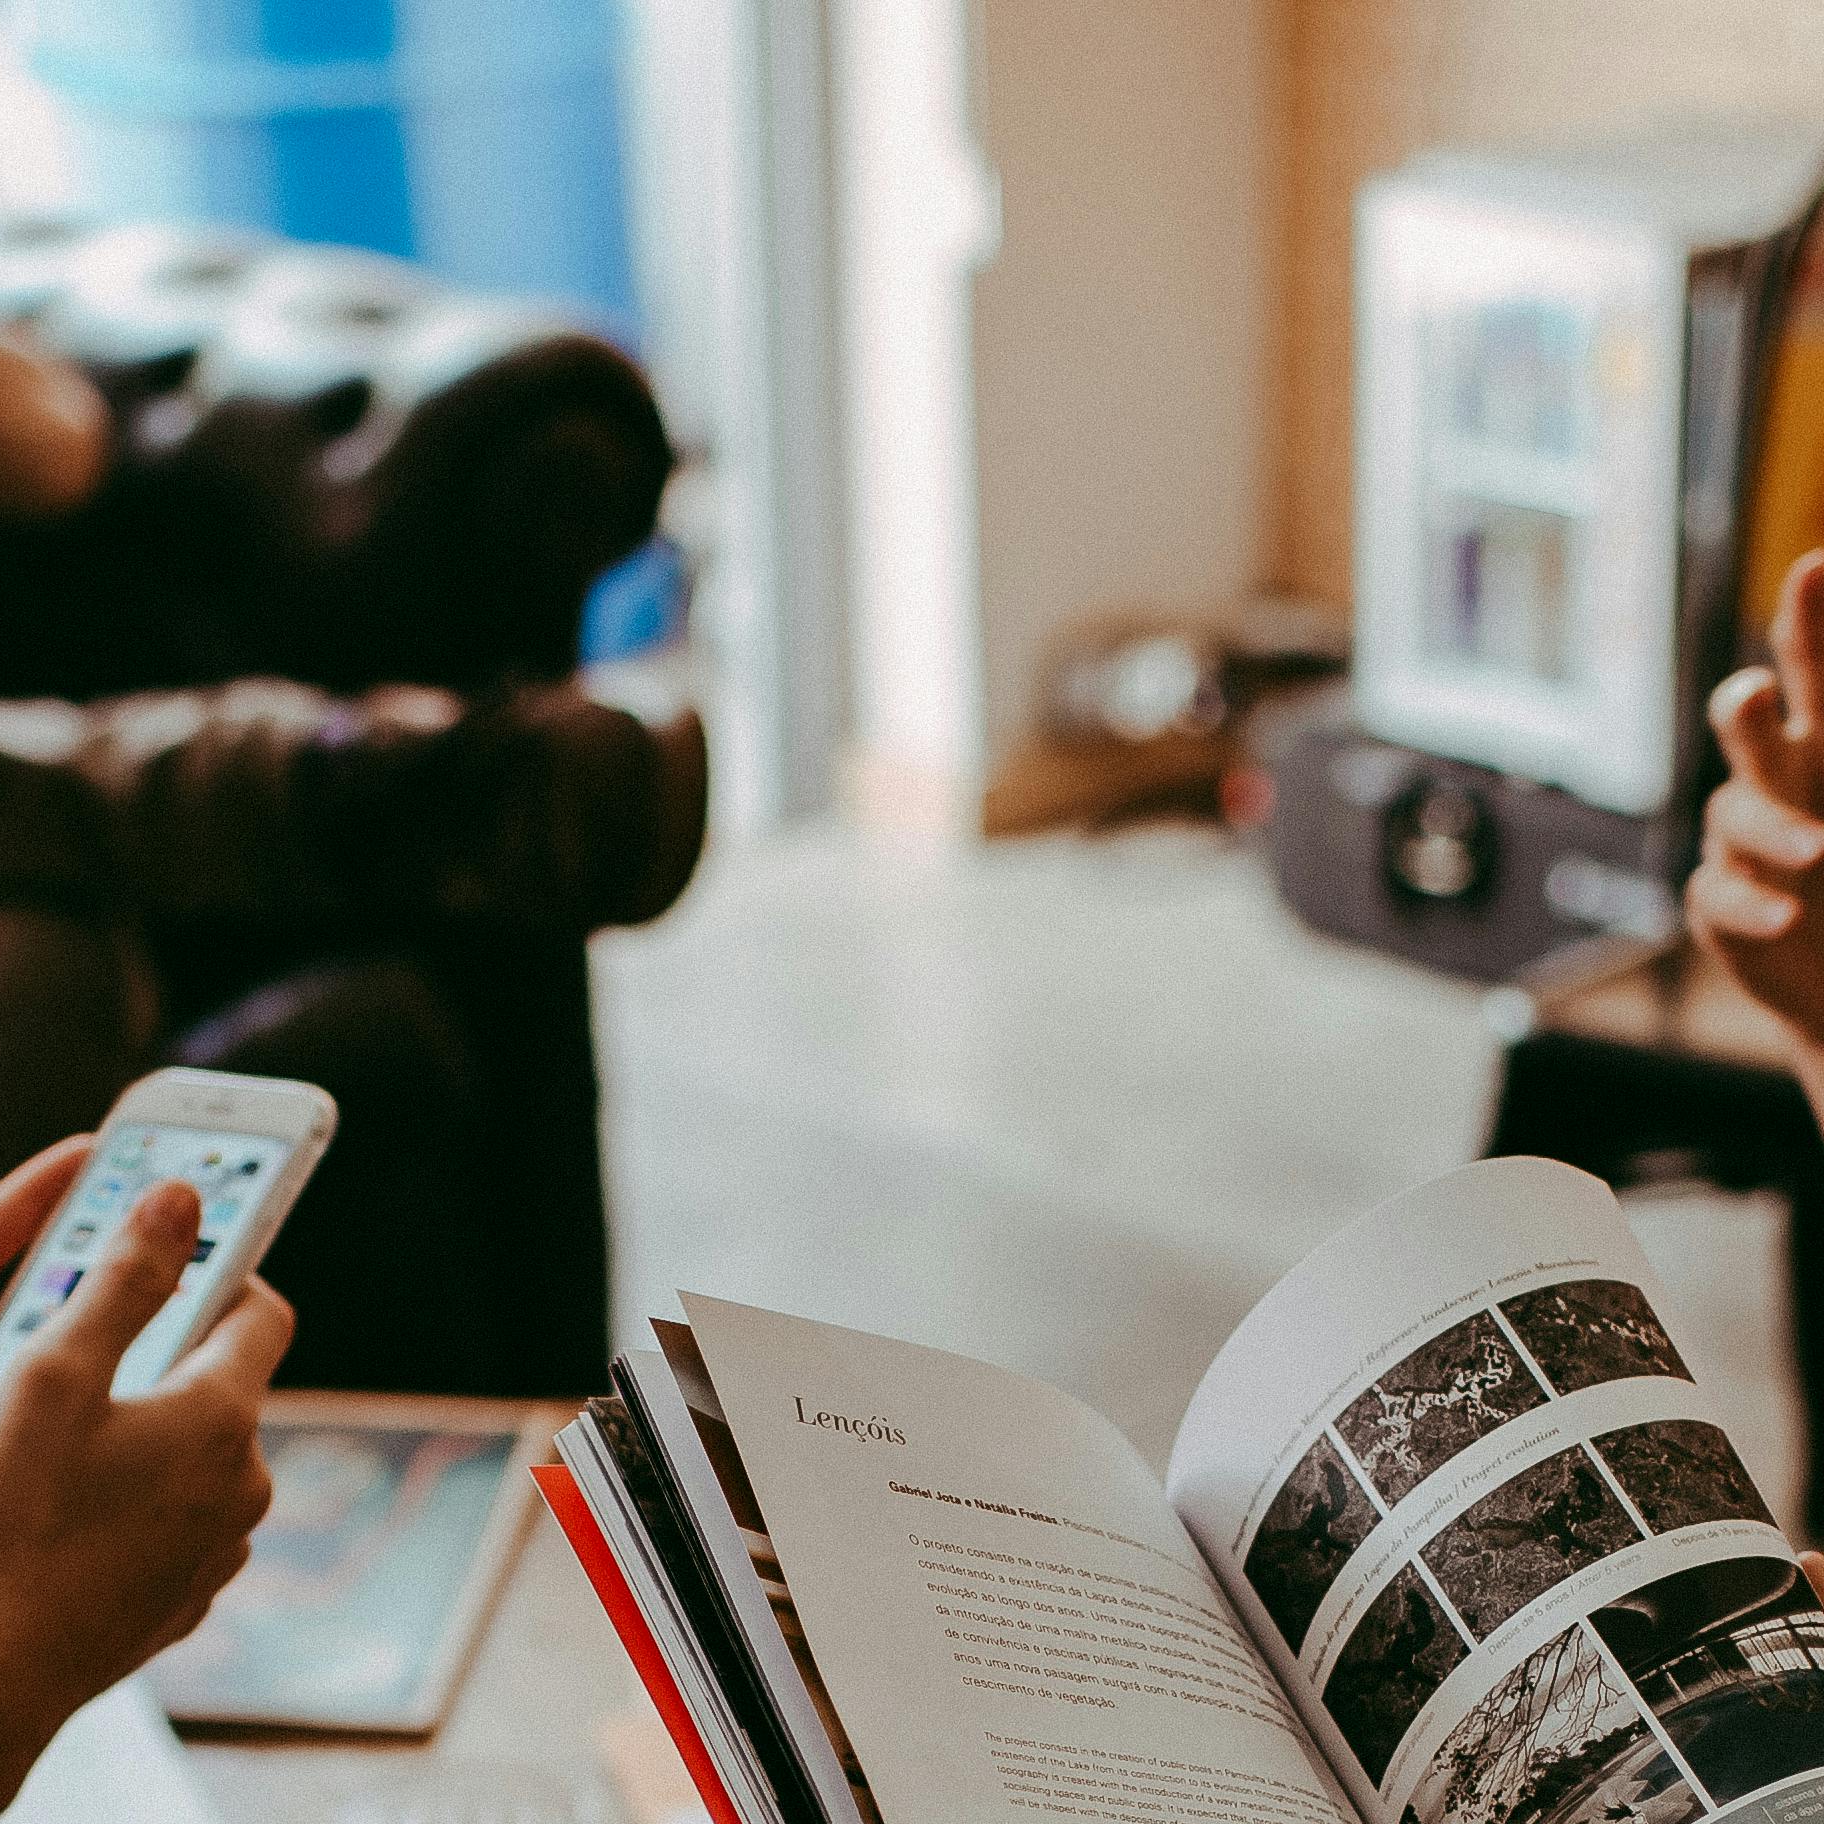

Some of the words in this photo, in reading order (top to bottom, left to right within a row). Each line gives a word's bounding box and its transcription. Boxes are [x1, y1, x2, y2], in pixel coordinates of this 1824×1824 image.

[792, 1395, 907, 1446] Lençóis
[888, 1480, 932, 1498] Gabriel
[936, 1491, 961, 1504] Jota
[1390, 1538, 1404, 1553] da
[1403, 1493, 1454, 1538] Pampulha
[1462, 1457, 1502, 1489] Project
[1505, 1427, 1560, 1460] evolution
[922, 1539, 963, 1554] projeto
[966, 1547, 1014, 1564] consiste
[1017, 1557, 1032, 1567] na
[1034, 1560, 1074, 1575] criação
[1076, 1568, 1091, 1578] de
[917, 1559, 995, 1581] considerando
[1008, 1576, 1065, 1594] existência
[1068, 1586, 1082, 1597] da
[1083, 1588, 1117, 1604] Lagoa
[926, 1582, 977, 1599] evolução
[981, 1592, 995, 1602] ao
[996, 1593, 1030, 1610] longo
[1032, 1601, 1054, 1613] dos
[1057, 1606, 1087, 1618] anos.
[1090, 1610, 1117, 1624] Uma
[1119, 1618, 1146, 1630] nova
[1487, 1626, 1520, 1655] Depois
[1522, 1615, 1535, 1628] de
[1544, 1591, 1570, 1611] anos
[1578, 1570, 1602, 1590] After
[1613, 1554, 1642, 1571] years
[935, 1604, 950, 1615] da
[953, 1609, 1014, 1627] introdução
[1016, 1620, 1031, 1630] de
[1034, 1624, 1060, 1635] uma
[1062, 1628, 1097, 1641] malha
[1100, 1634, 1147, 1651] metálica
[944, 1627, 959, 1639] de
[962, 1632, 1030, 1651] convivência
[1043, 1646, 1090, 1661] piscinas
[953, 1652, 981, 1664] anos
[984, 1659, 1010, 1670] uma
[1013, 1663, 1040, 1675] nova
[1043, 1668, 1099, 1684] paisagem
[1101, 1677, 1141, 1691] surgirá
[1143, 1684, 1168, 1695] com
[962, 1676, 1035, 1696] crescimento
[1037, 1687, 1052, 1698] de
[1055, 1692, 1118, 1708] vegetação.
[984, 1731, 1001, 1742] The
[1004, 1736, 1037, 1748] project
[1038, 1742, 1077, 1754] consists
[1090, 1749, 1106, 1757] the
[1108, 1752, 1145, 1763] creation
[1147, 1757, 1156, 1765] of
[1159, 1760, 1186, 1770] public
[1188, 1764, 1212, 1774] pools
[990, 1749, 1035, 1762] existence
[1037, 1755, 1047, 1764] of
[1049, 1758, 1065, 1767] the
[1067, 1760, 1090, 1770] Lake
[1092, 1763, 1114, 1773] from
[1117, 1768, 1128, 1776] its
[1130, 1770, 1186, 1784] construction
[1188, 1778, 1198, 1786] to
[1200, 1780, 1211, 1788] its
[1213, 1782, 1253, 1794] evolution
[996, 1765, 1048, 1780] topography
[1061, 1775, 1097, 1786] created
[1098, 1781, 1119, 1789] with
[1121, 1783, 1137, 1792] the
[1139, 1787, 1193, 1799] introduction
[1195, 1793, 1204, 1802] of
[1215, 1798, 1237, 1808] wavy
[1240, 1801, 1274, 1813] metallic
[1002, 1781, 1050, 1797] socializing
[1053, 1789, 1085, 1800] spaces
[1088, 1794, 1105, 1803] and
[1107, 1797, 1134, 1807] public
[1137, 1801, 1163, 1812] pools.
[1167, 1804, 1174, 1813] It
[1186, 1808, 1228, 1820] expected
[1008, 1797, 1025, 1806] will
[1027, 1800, 1039, 1808] be
[1042, 1802, 1076, 1814] shaped
[1101, 1811, 1116, 1820] the
[1784, 1811, 1798, 1823] da
[1799, 1802, 1823, 1818] água
